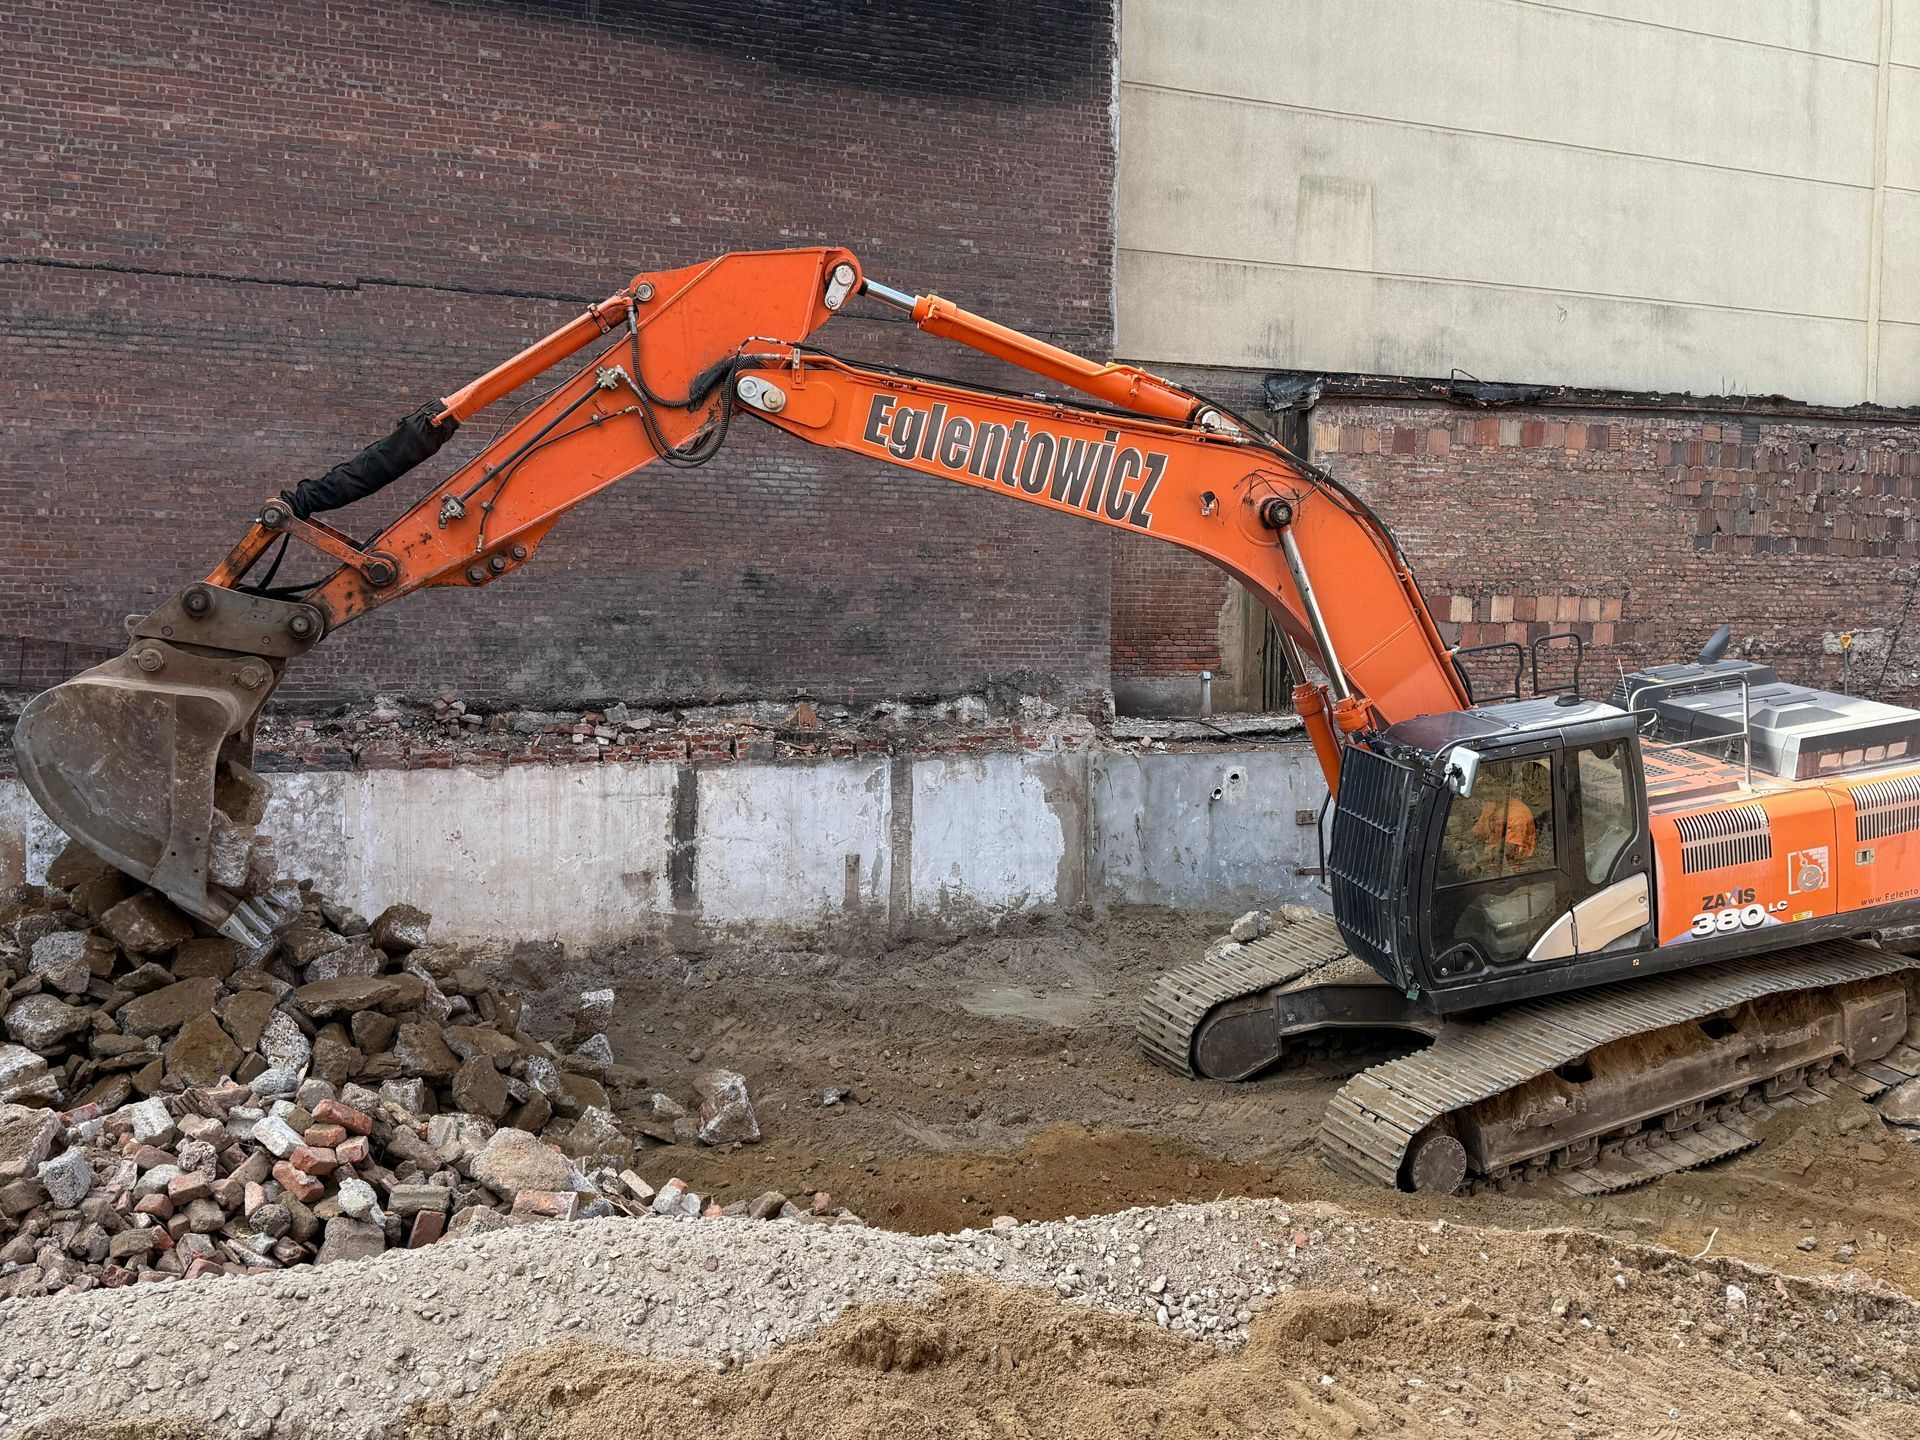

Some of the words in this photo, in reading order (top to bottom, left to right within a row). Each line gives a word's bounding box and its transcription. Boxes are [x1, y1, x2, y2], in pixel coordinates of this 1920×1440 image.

[863, 393, 1168, 530] Eglentowicz
[1702, 886, 1756, 911] ZAXIS
[1691, 903, 1766, 938] 380
[1768, 900, 1788, 913] LC
